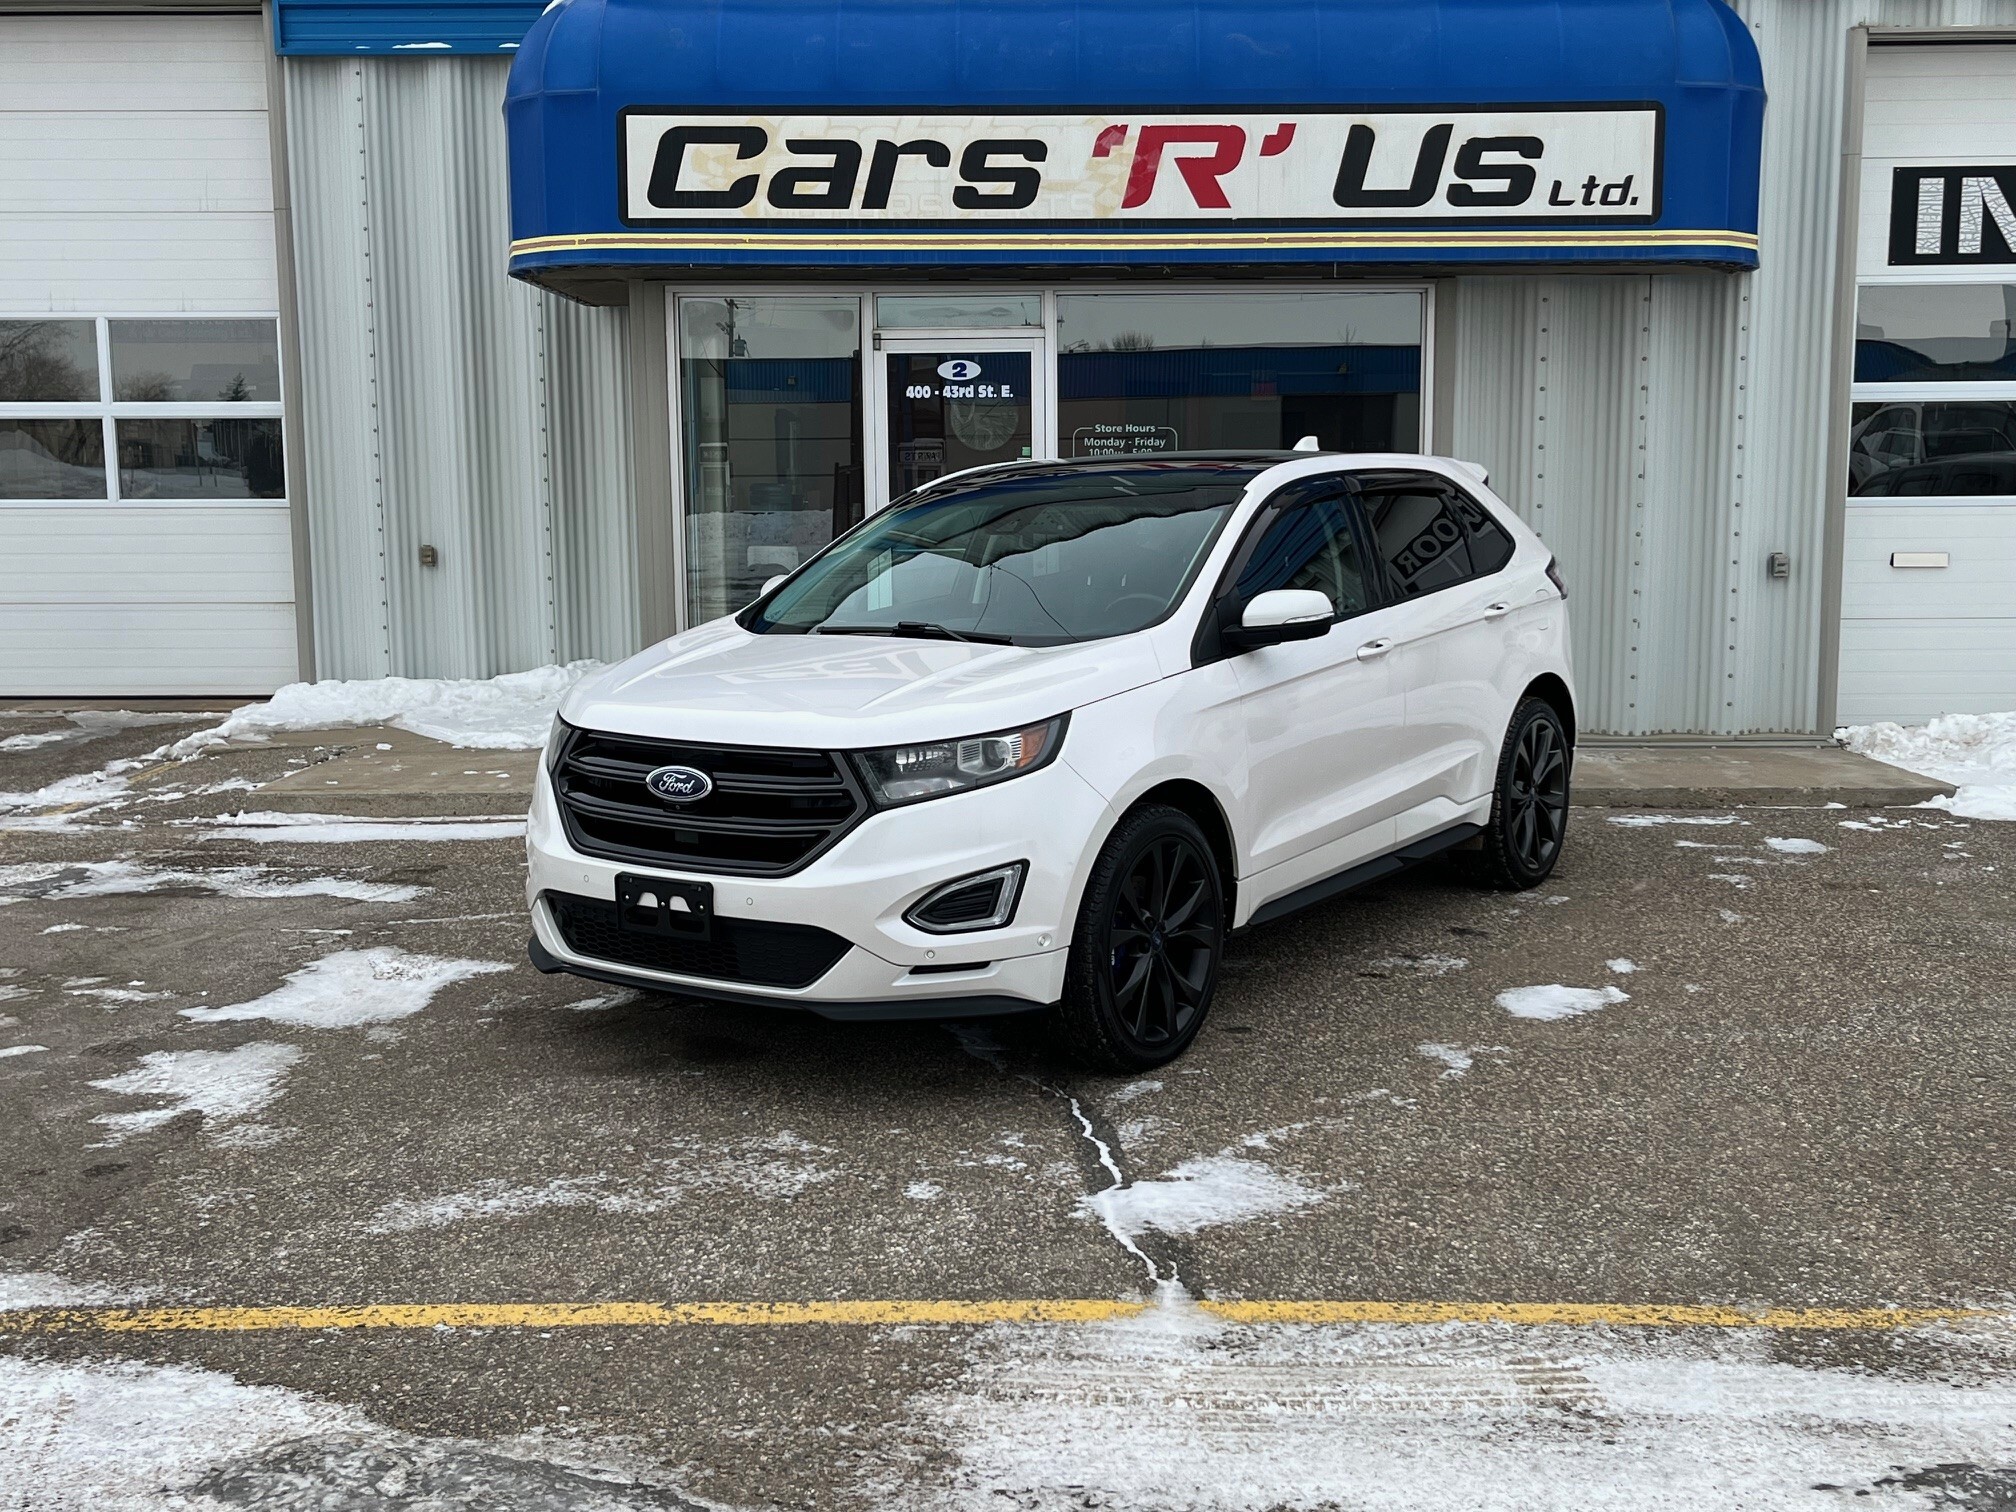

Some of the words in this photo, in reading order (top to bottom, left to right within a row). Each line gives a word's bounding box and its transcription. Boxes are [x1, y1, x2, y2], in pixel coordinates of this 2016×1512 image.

[647, 125, 1048, 210] Cars
[1332, 123, 1545, 208] Us
[1548, 174, 1639, 207] Ltd.
[951, 362, 968, 378] 2
[905, 385, 932, 399] 400
[942, 384, 975, 398] 43rd
[978, 384, 998, 398] St.
[1001, 384, 1014, 398] E.
[1094, 424, 1123, 433] Store
[1125, 424, 1156, 433] Hours
[1084, 437, 1126, 448] Monday
[1134, 437, 1166, 448] Friday
[658, 772, 696, 794] Ford
